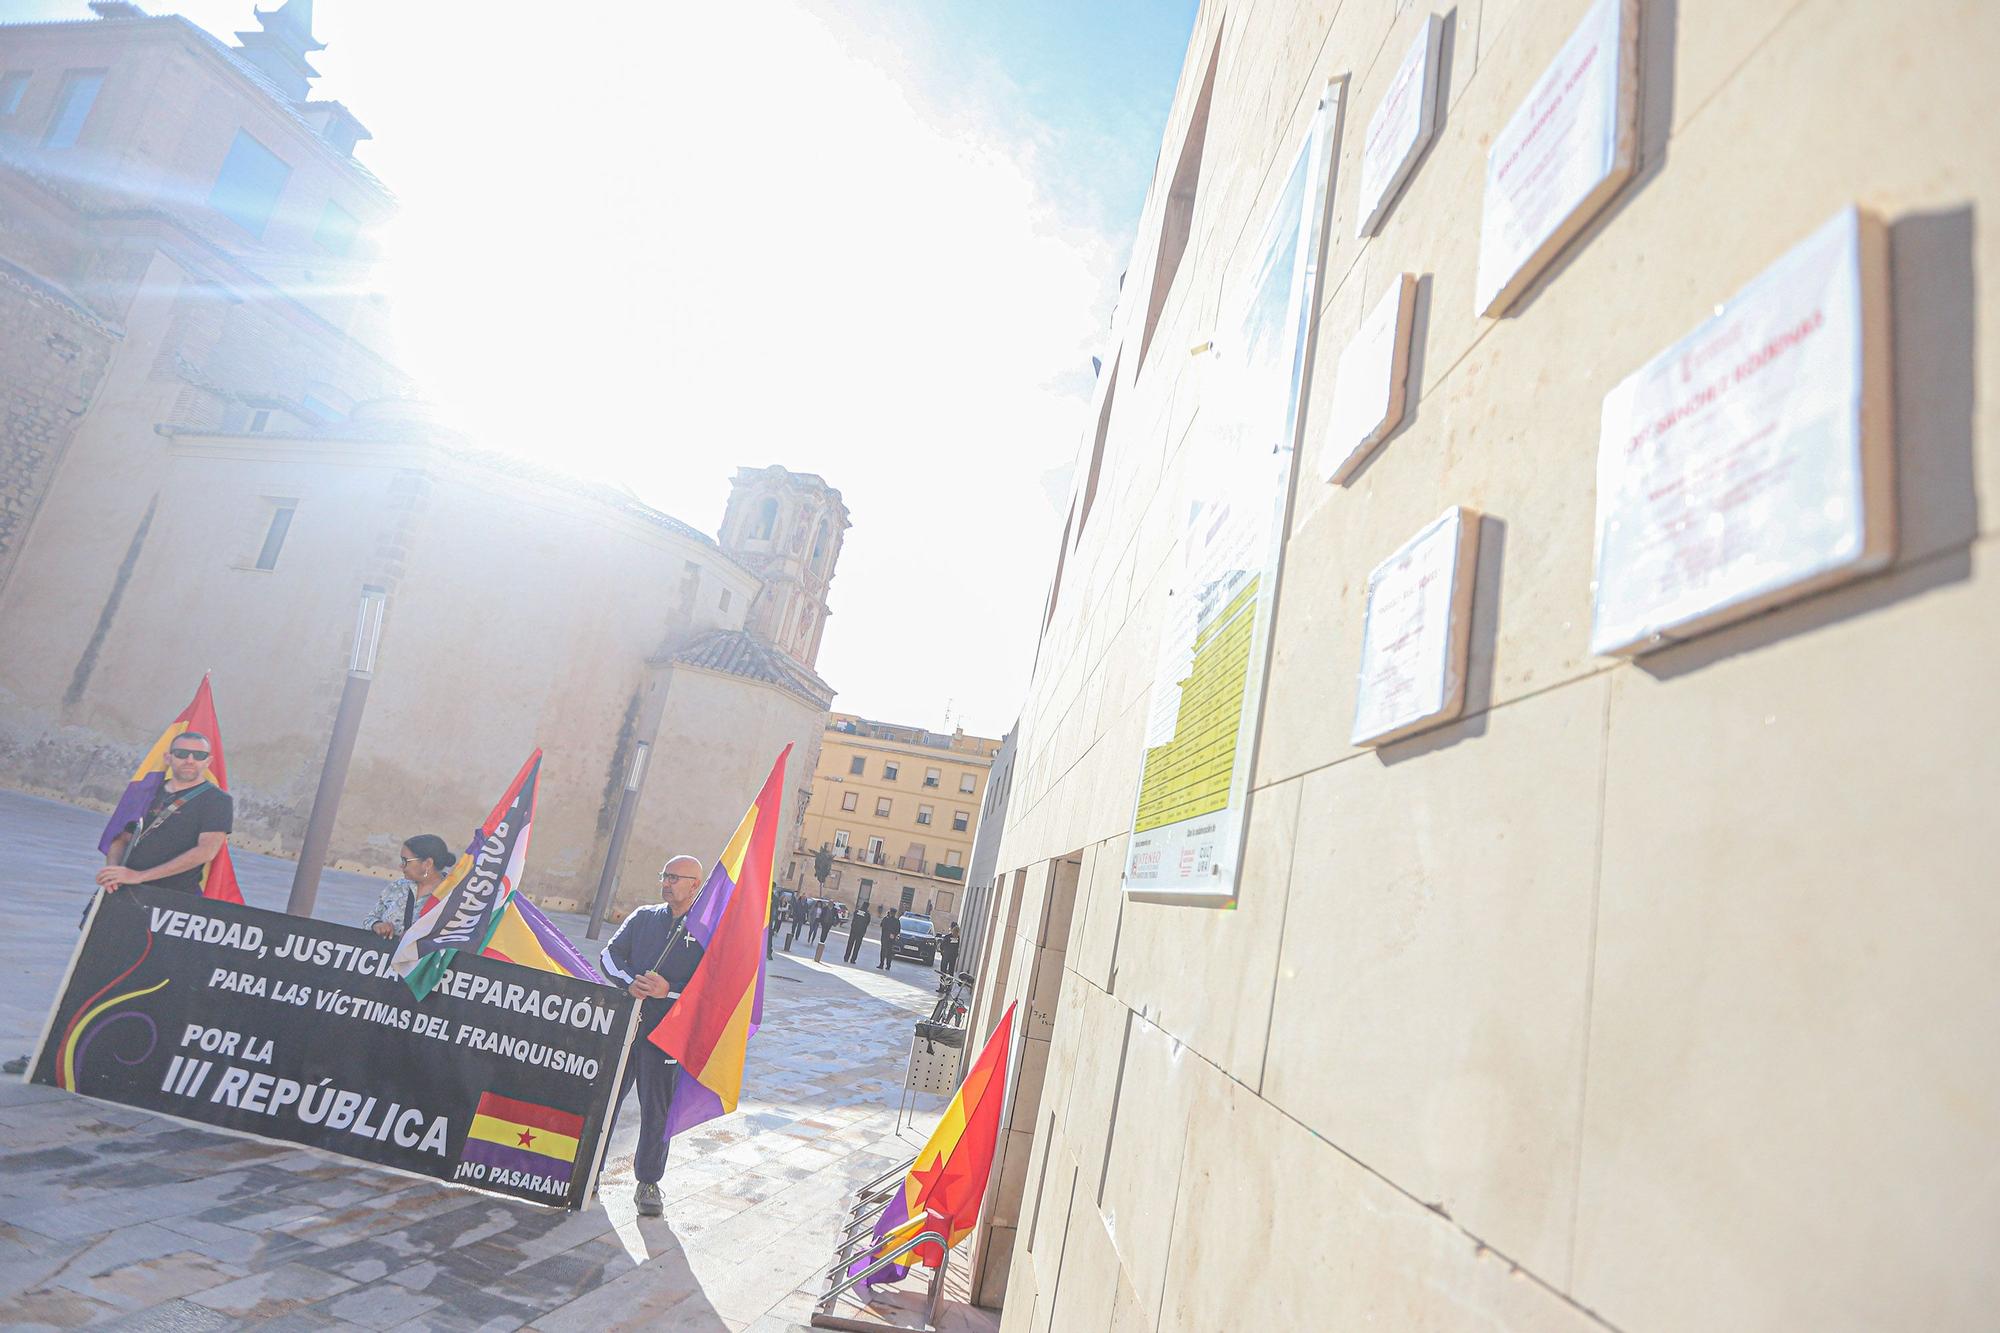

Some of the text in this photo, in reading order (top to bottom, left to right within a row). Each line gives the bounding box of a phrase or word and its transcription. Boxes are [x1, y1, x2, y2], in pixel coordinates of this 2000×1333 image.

[150, 907, 615, 1035] VERDAD, JUSTICIA REPARACIÓN
[180, 1024, 275, 1065] POR LA
[208, 968, 599, 1080] PARA LAS VÍCTIMAS DEL FRANQUISMO
[161, 1056, 449, 1157] III REPÚBLICA
[453, 1161, 571, 1197] ¡NO PASARÁN!
